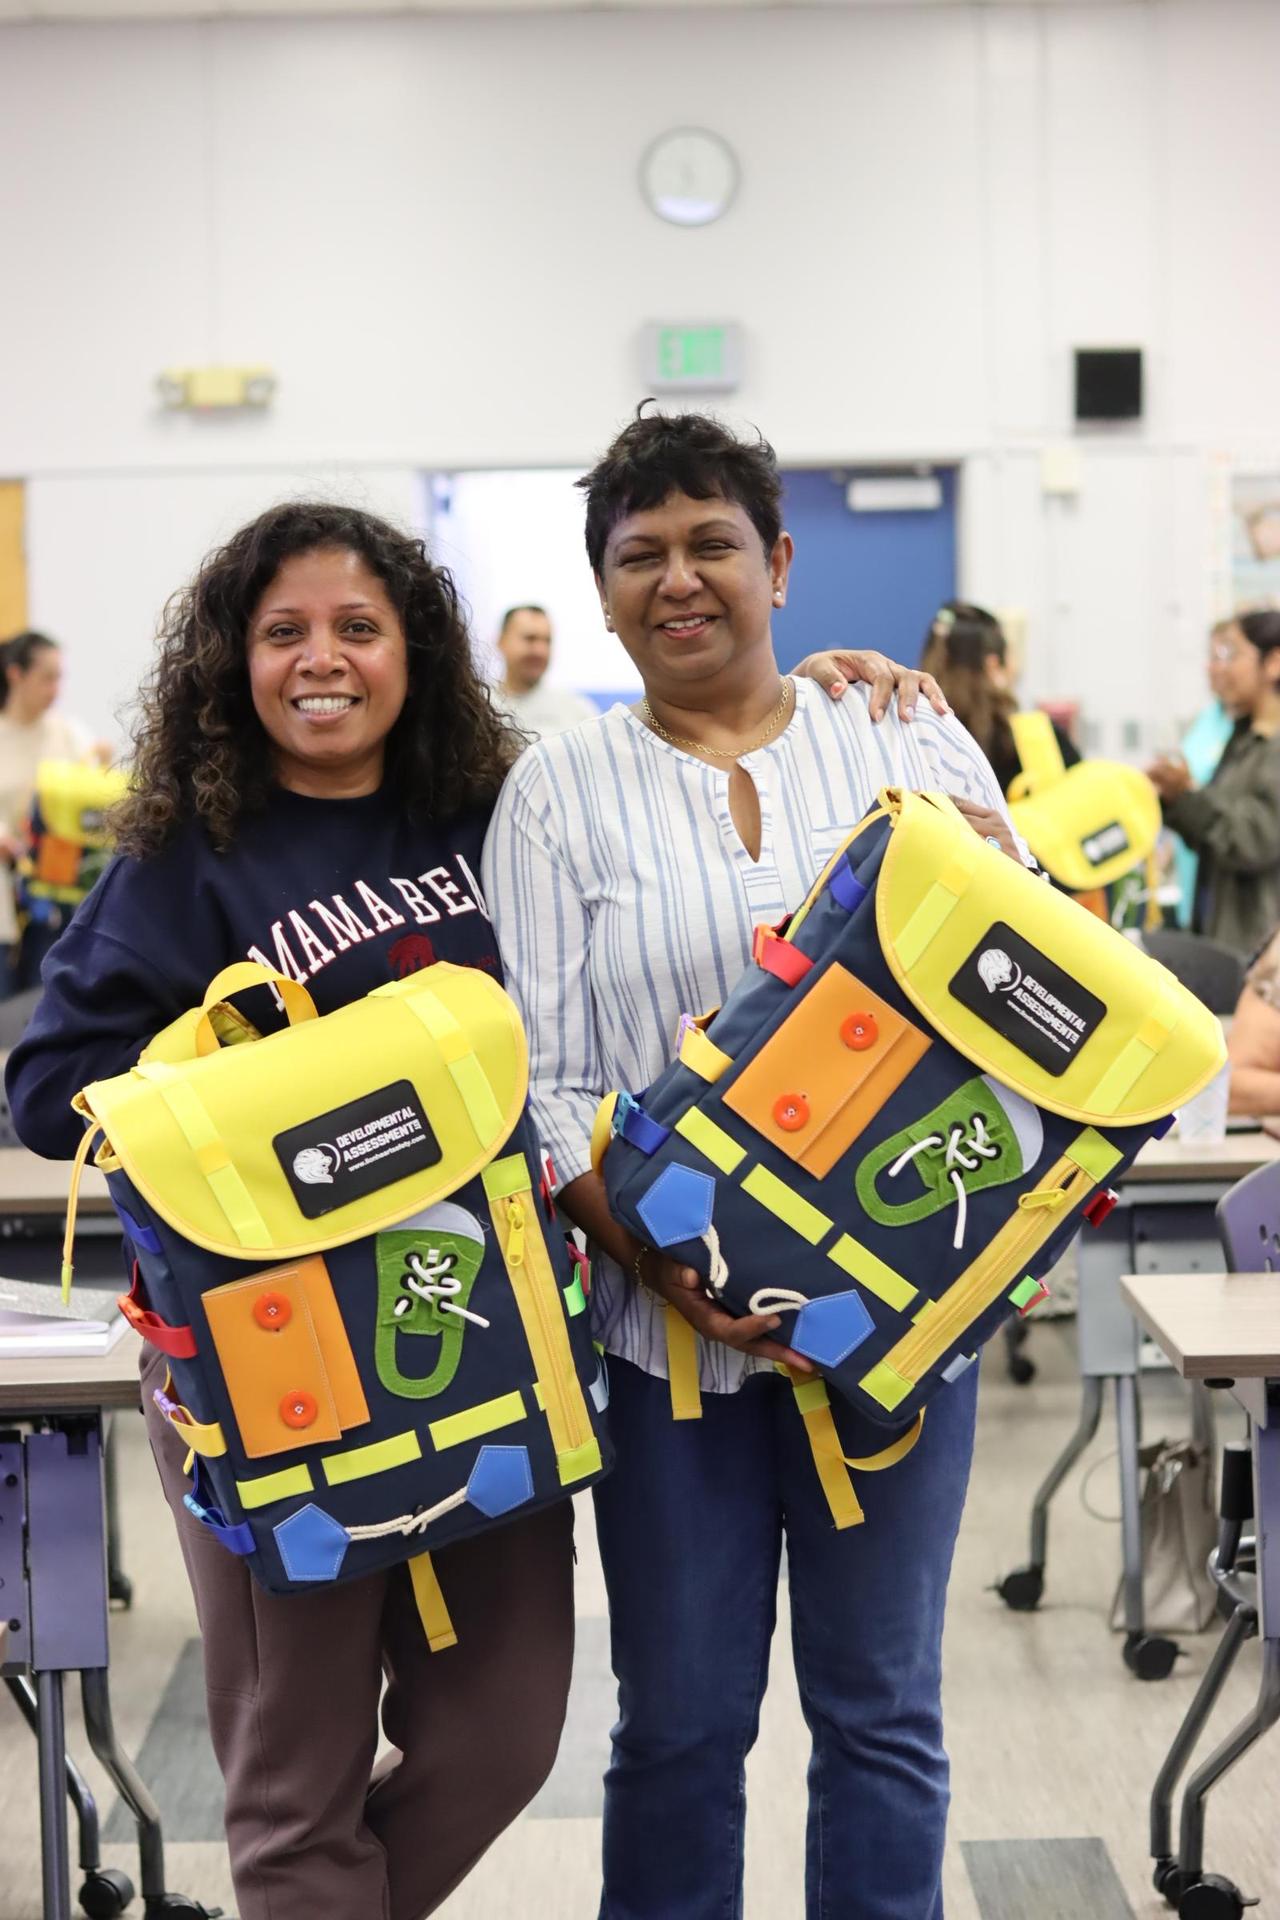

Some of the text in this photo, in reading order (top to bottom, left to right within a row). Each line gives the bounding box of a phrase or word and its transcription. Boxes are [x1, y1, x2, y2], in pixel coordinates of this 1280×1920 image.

[658, 327, 724, 379] EXIT
[247, 880, 405, 1012] MAMA
[1022, 974, 1086, 1032] DEVELOPMENTAL
[336, 1106, 416, 1148] DEVELOPMENTAL
